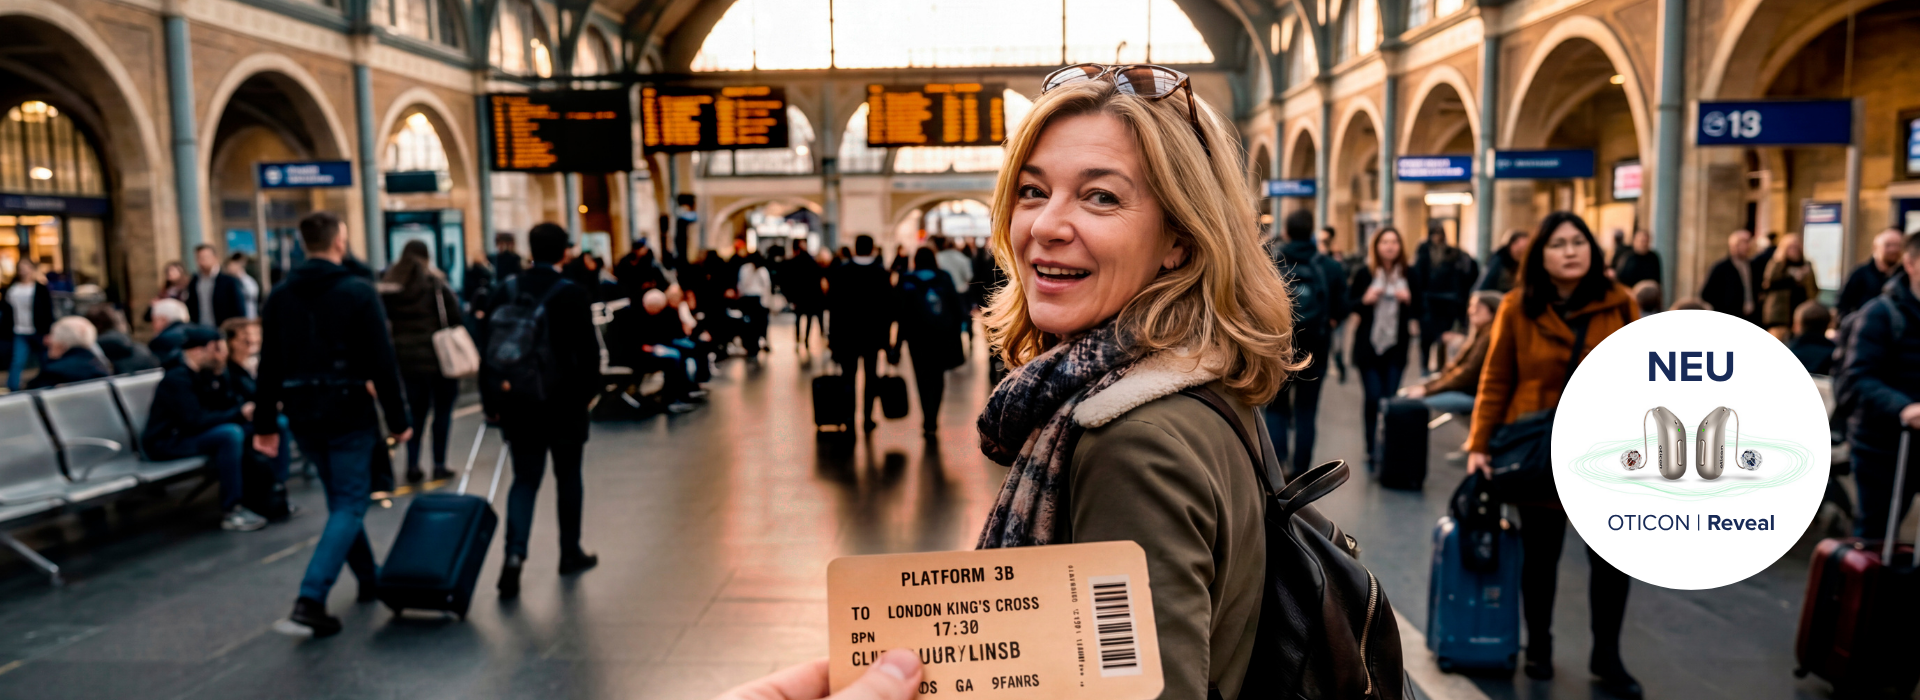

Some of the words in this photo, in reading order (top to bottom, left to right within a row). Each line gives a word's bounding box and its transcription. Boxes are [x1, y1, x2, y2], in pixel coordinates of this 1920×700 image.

[1727, 109, 1762, 138] 13
[901, 567, 985, 587] PLATFORM
[994, 565, 1015, 581] 3B
[851, 606, 871, 621] TO
[888, 602, 942, 619] LONDON
[946, 599, 991, 616] KING'S
[995, 596, 1040, 612] CROSS
[851, 631, 875, 644] BPN
[933, 619, 979, 637] 17:30
[955, 678, 974, 693] GA
[991, 673, 1040, 690] 9FANRS
